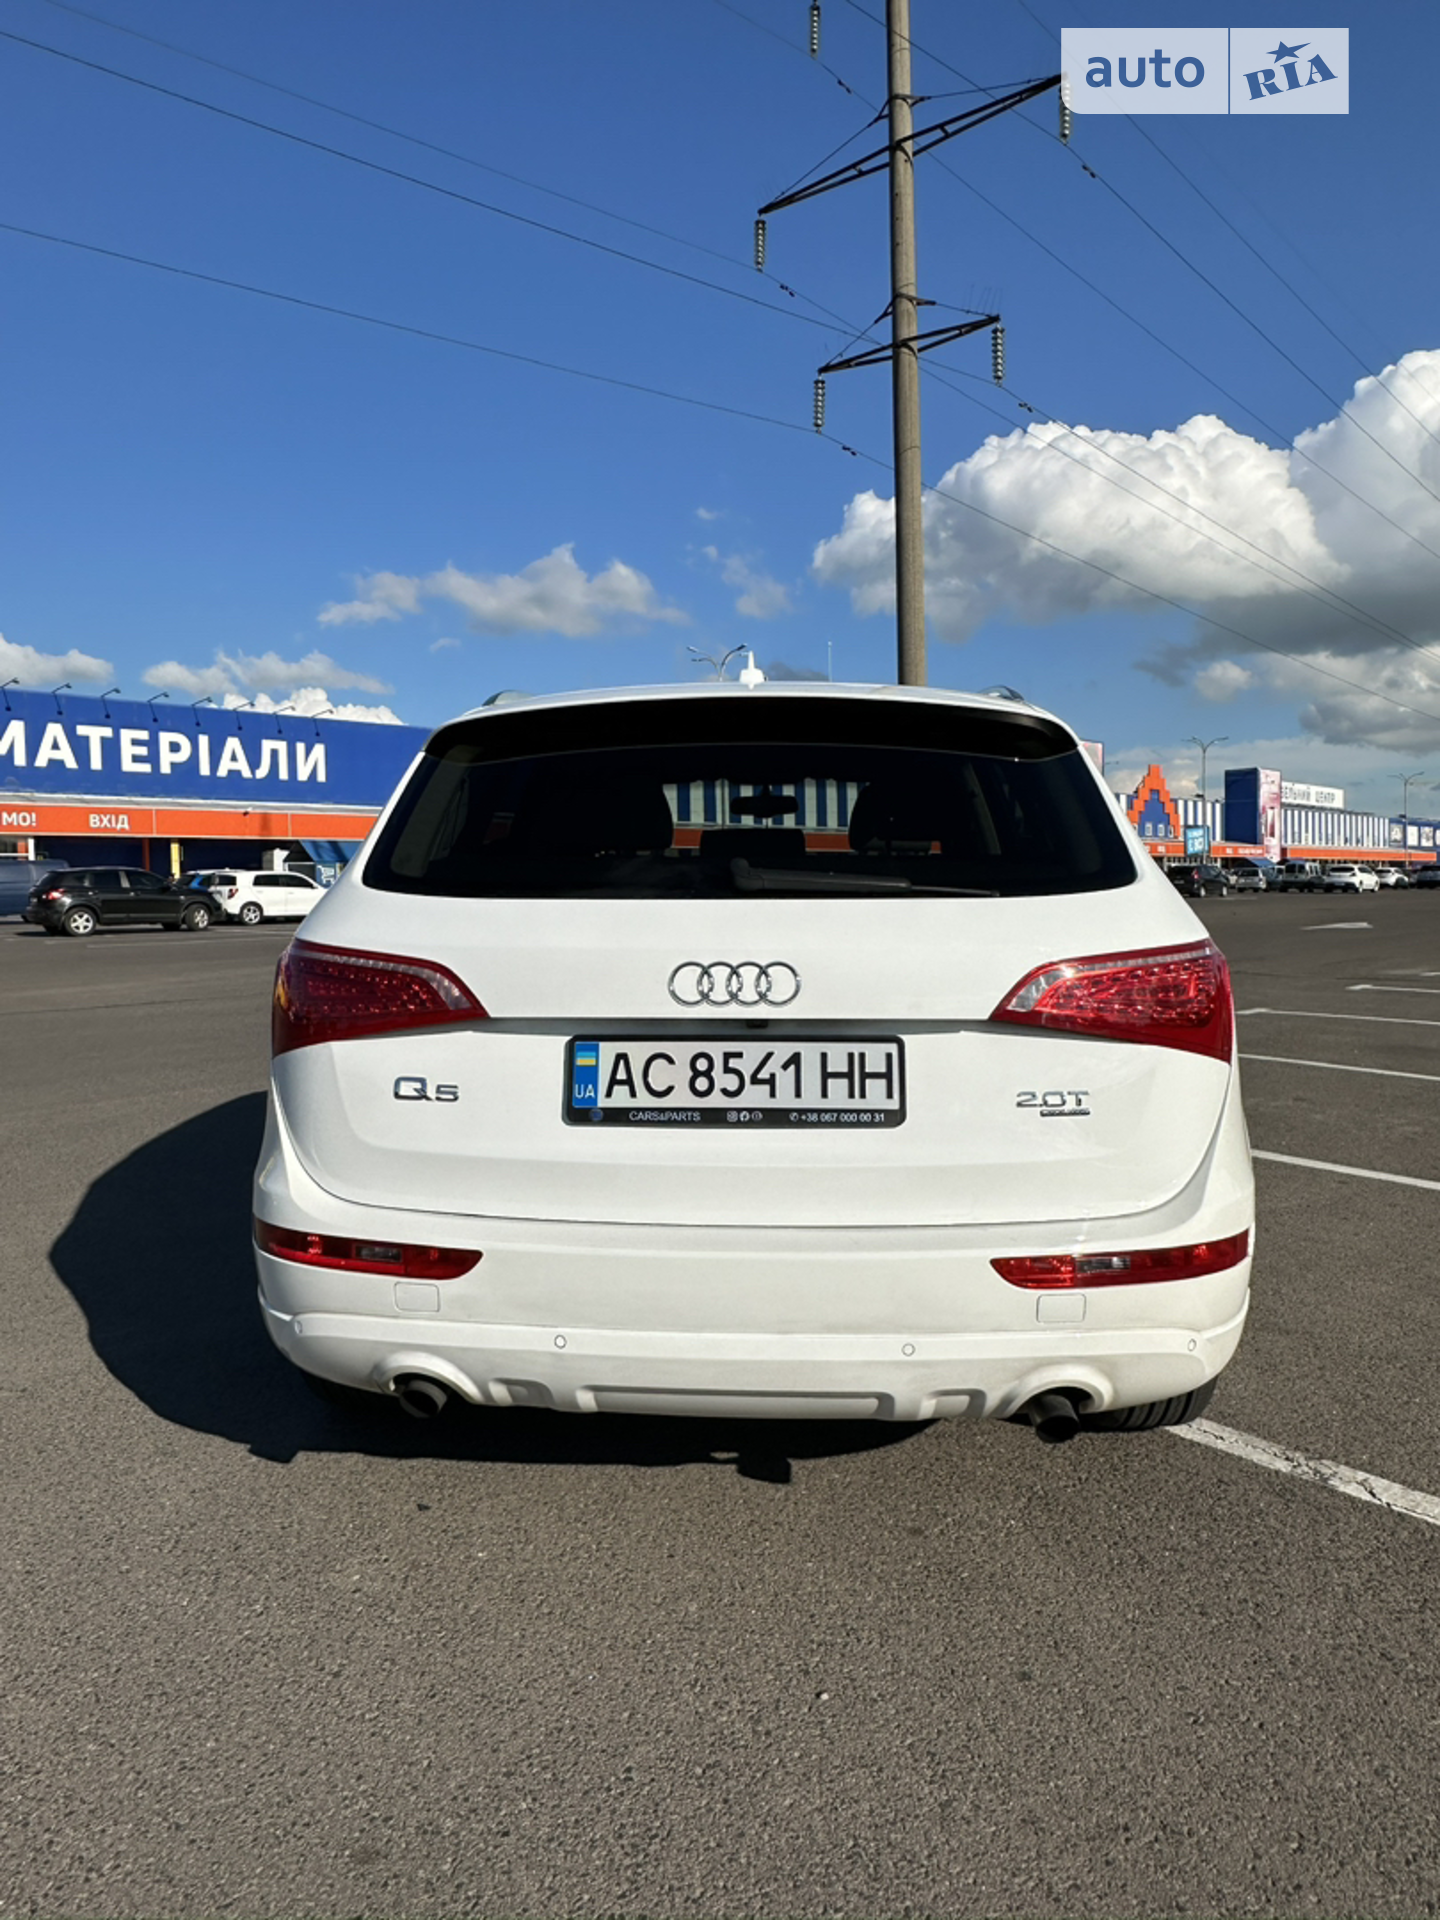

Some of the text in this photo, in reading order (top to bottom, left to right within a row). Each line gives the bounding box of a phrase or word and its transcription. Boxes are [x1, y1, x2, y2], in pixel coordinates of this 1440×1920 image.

[88, 813, 130, 831] ВХІД
[605, 1051, 894, 1099] AC 8541 HH
[394, 1076, 459, 1102] Q5
[575, 1084, 595, 1098] UA
[800, 1112, 819, 1122] +38
[839, 1112, 857, 1122] 000
[859, 1112, 872, 1122] 00
[873, 1112, 886, 1122] 31
